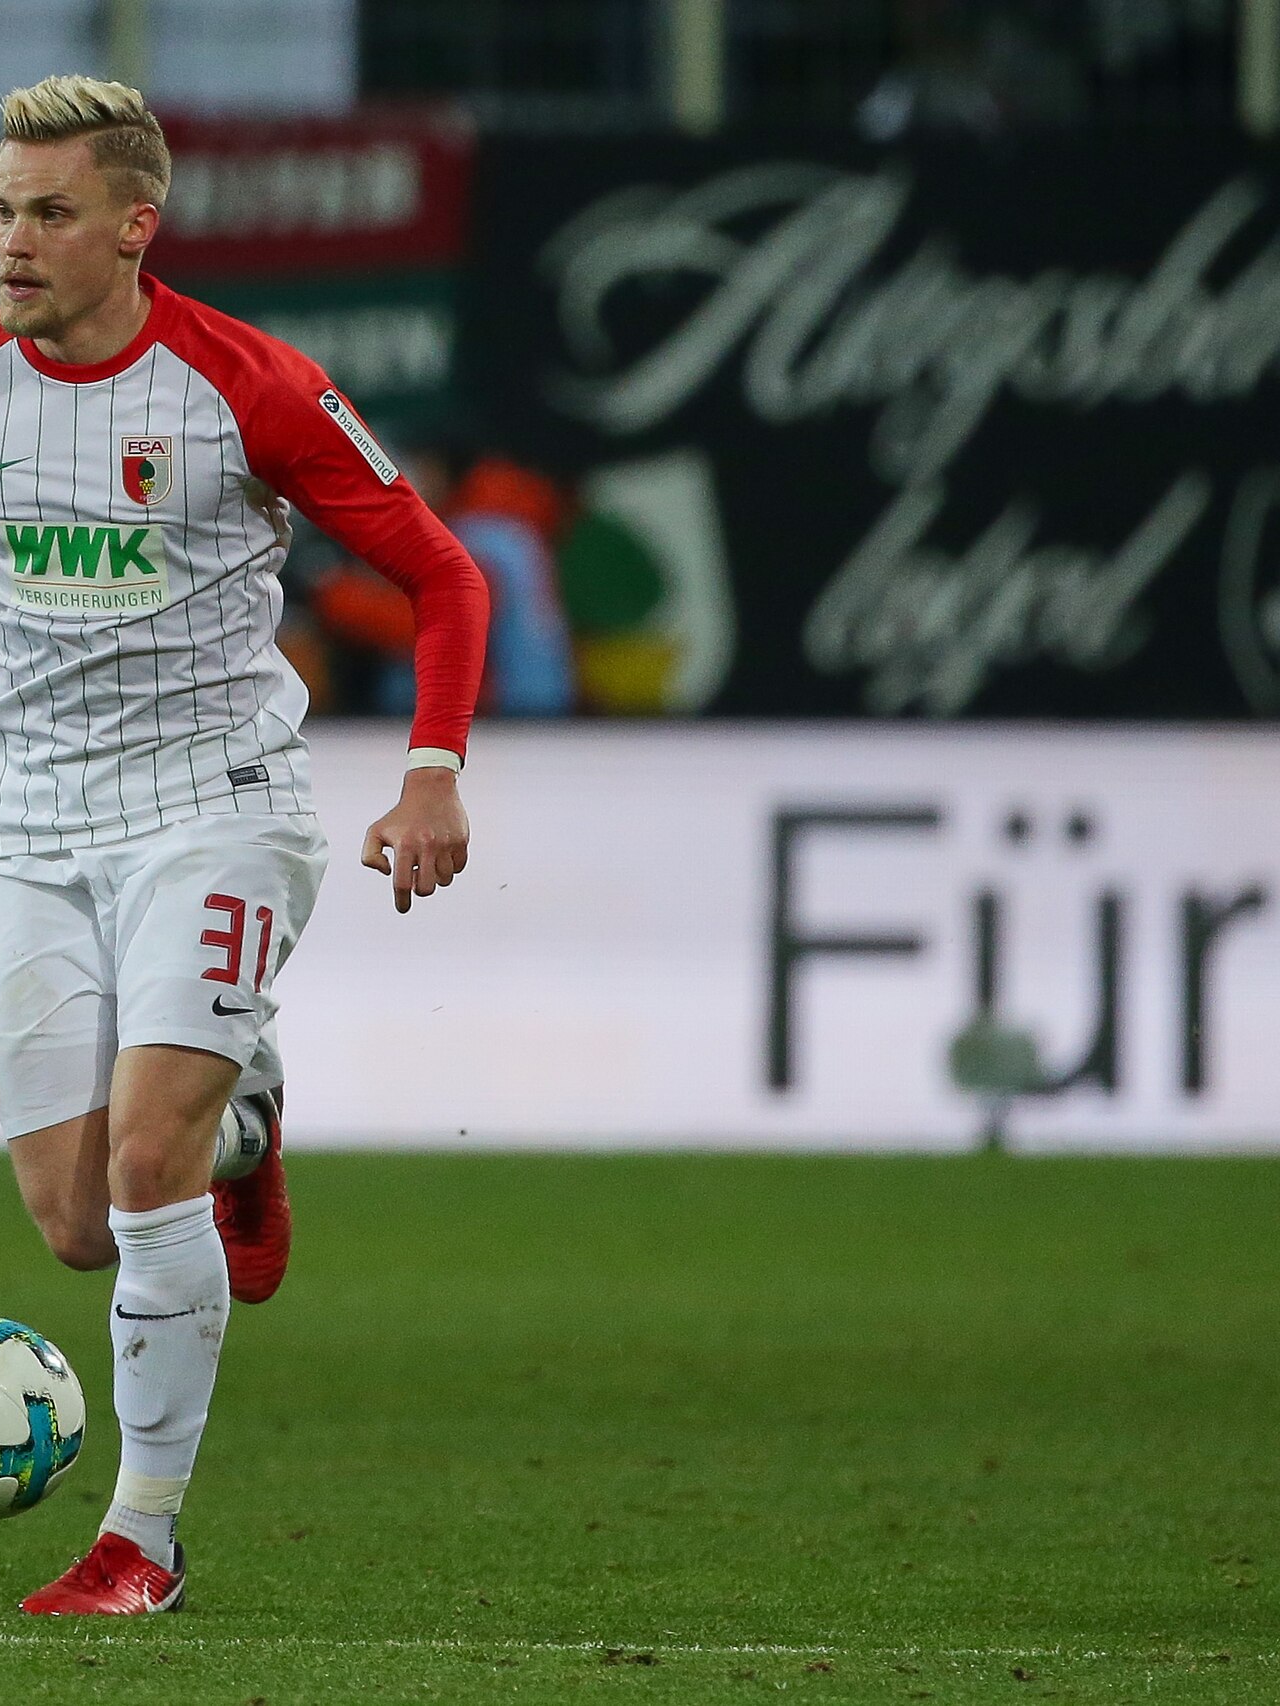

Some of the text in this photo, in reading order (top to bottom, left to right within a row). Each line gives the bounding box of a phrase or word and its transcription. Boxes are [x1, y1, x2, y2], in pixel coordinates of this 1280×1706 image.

[128, 440, 166, 455] FCA
[338, 411, 397, 483] baramundi
[5, 524, 159, 579] WWK
[15, 587, 163, 610] VERSICHERUNGEN
[200, 892, 274, 994] 31
[768, 804, 1268, 1097] Für
